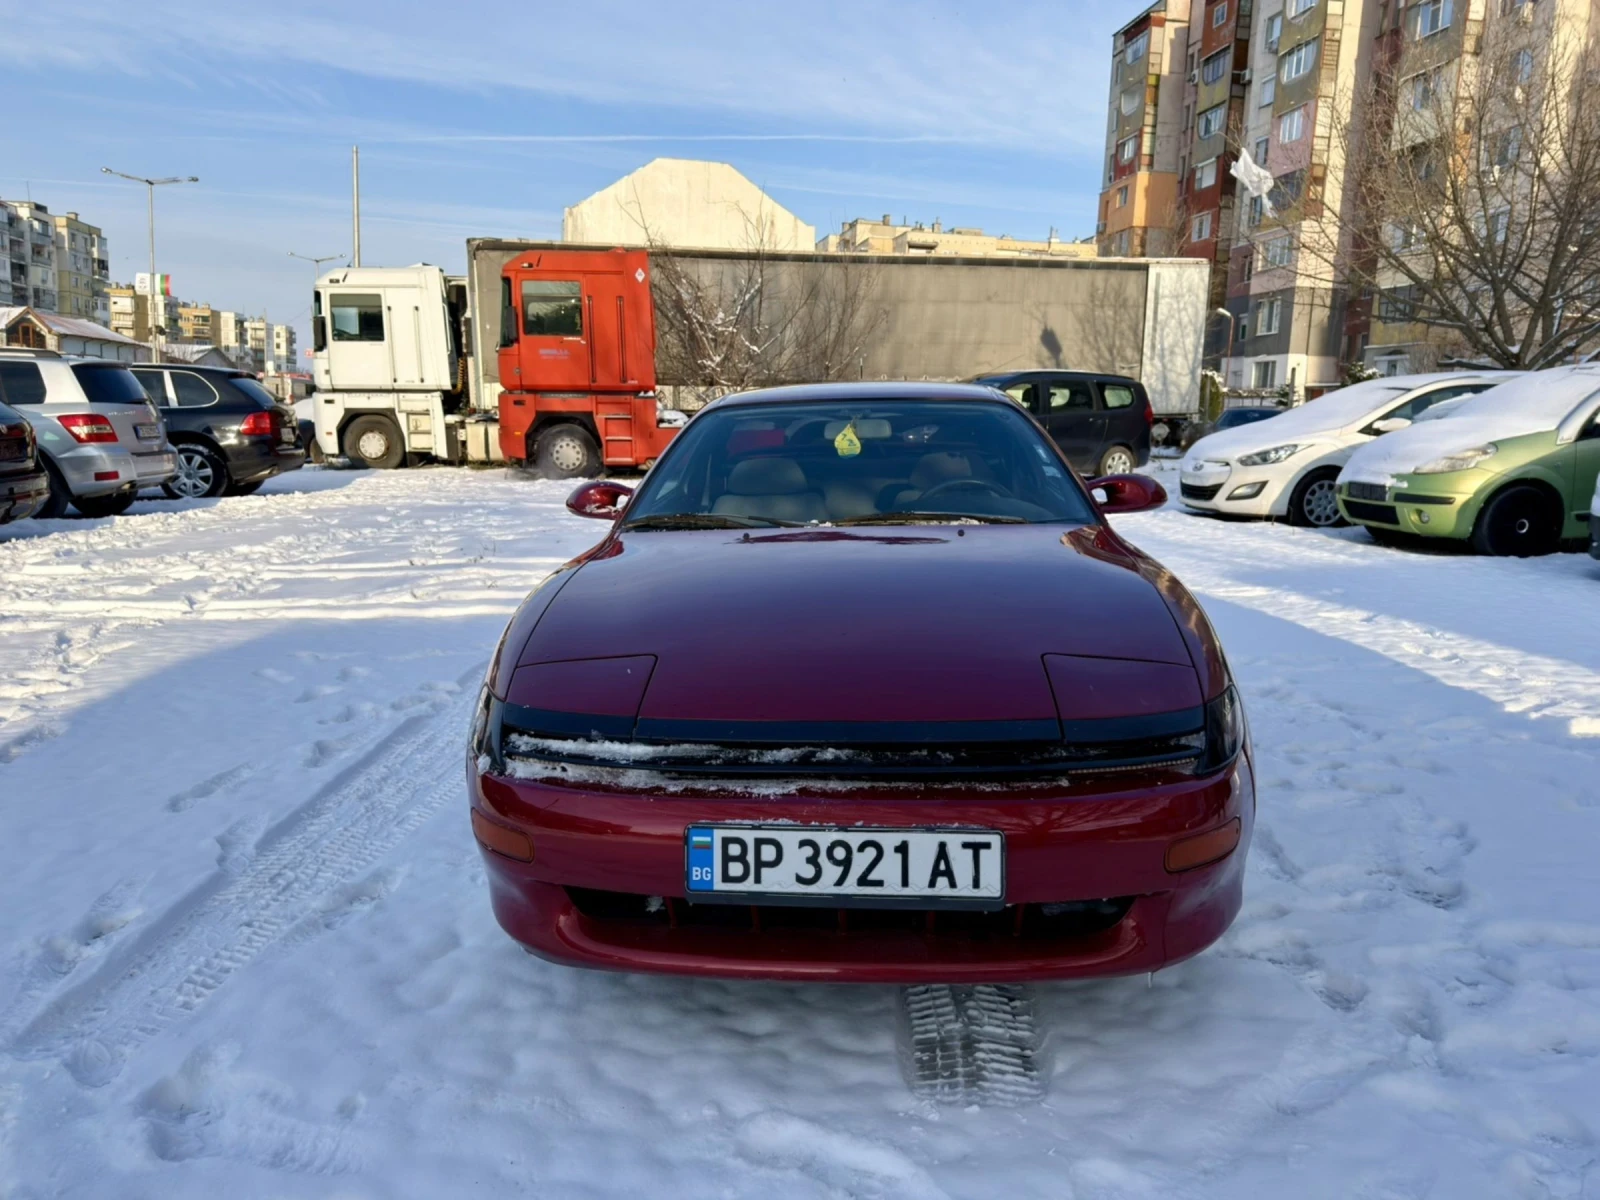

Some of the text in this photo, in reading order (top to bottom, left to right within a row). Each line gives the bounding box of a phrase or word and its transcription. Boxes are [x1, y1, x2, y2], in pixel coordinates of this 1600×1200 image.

[692, 866, 712, 881] BG
[721, 836, 992, 889] BP 3921 AT
